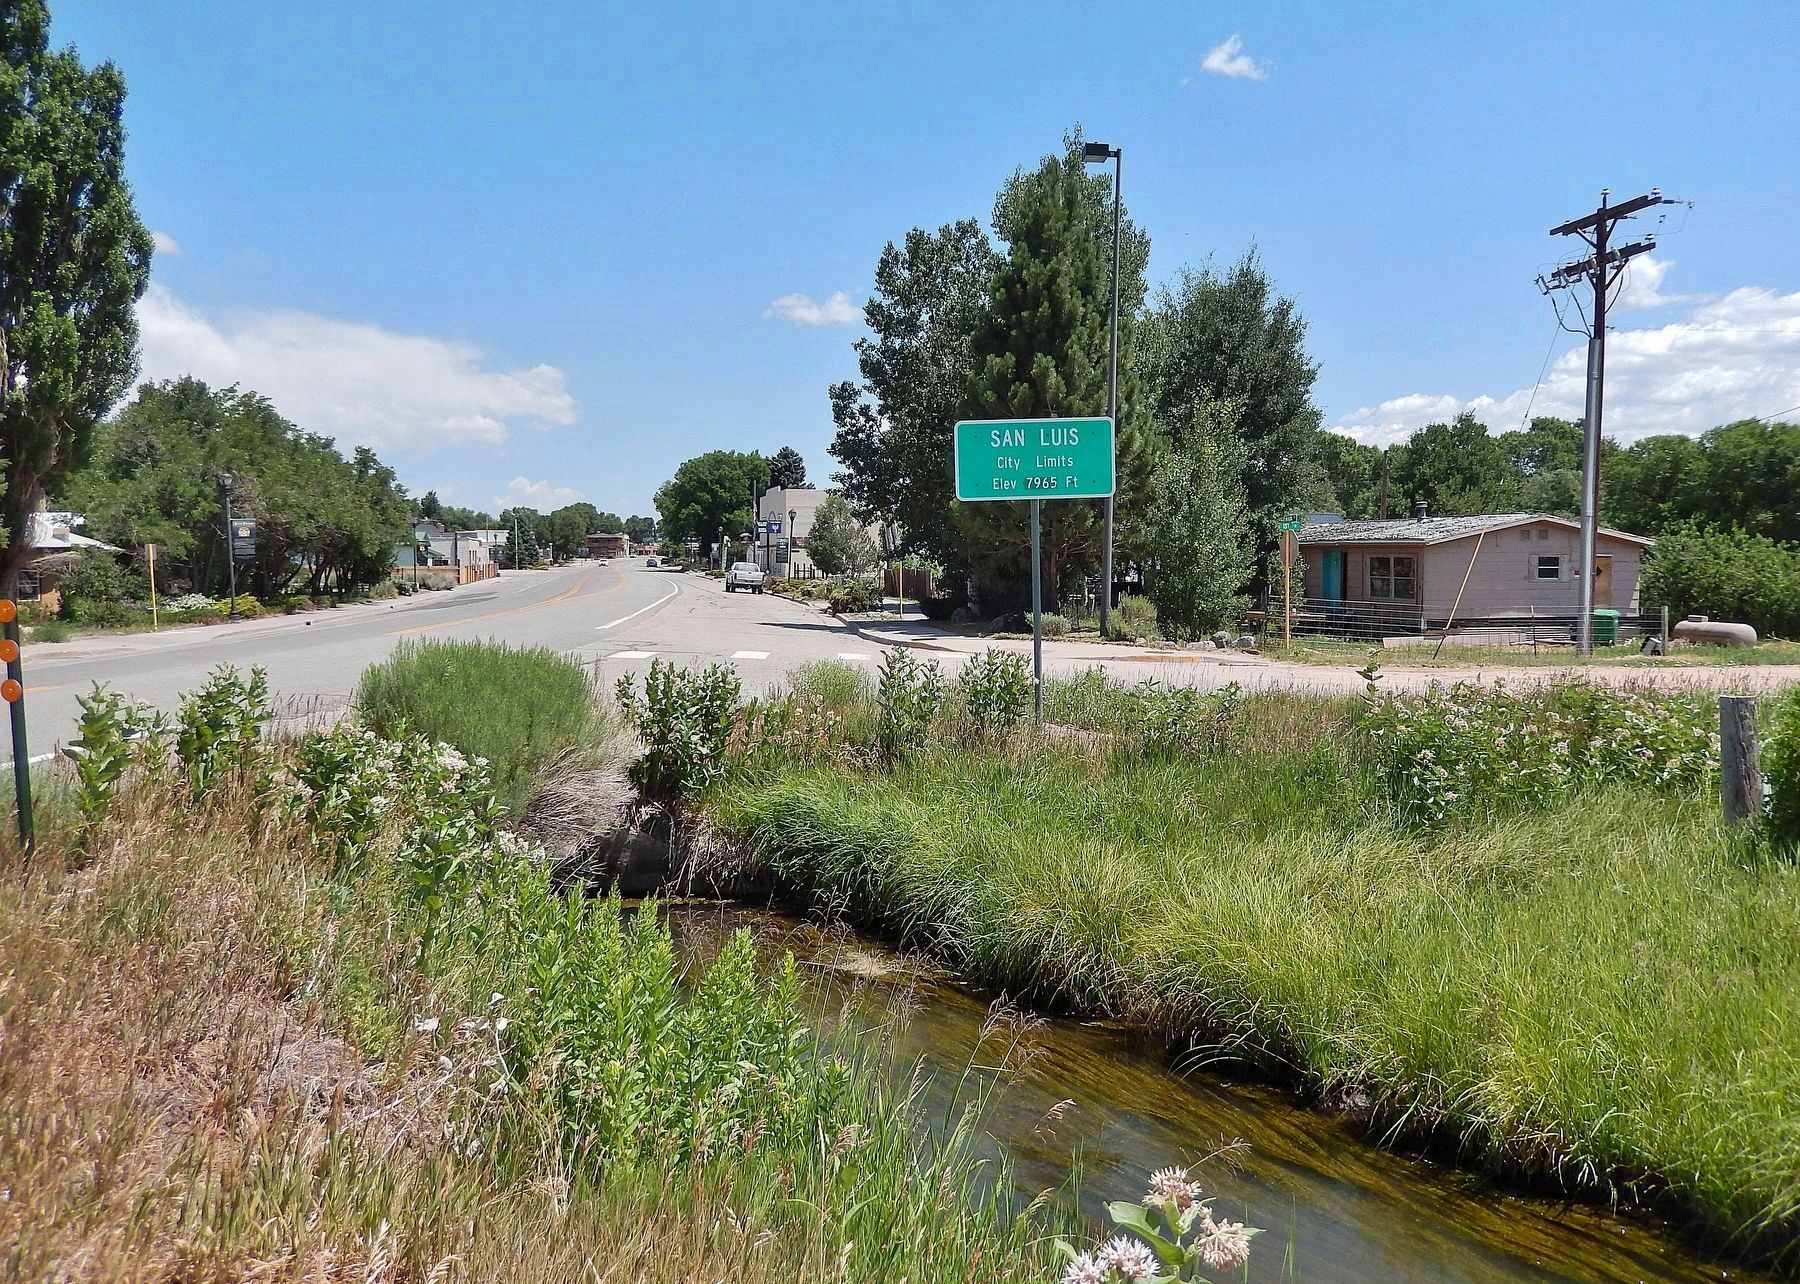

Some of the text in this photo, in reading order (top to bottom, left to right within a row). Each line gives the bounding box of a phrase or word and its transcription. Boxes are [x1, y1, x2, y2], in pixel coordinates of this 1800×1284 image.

[990, 428, 1079, 448] SAN LUIS
[997, 455, 1074, 471] City Limits
[993, 476, 1078, 490] Elev 7965 Ft
